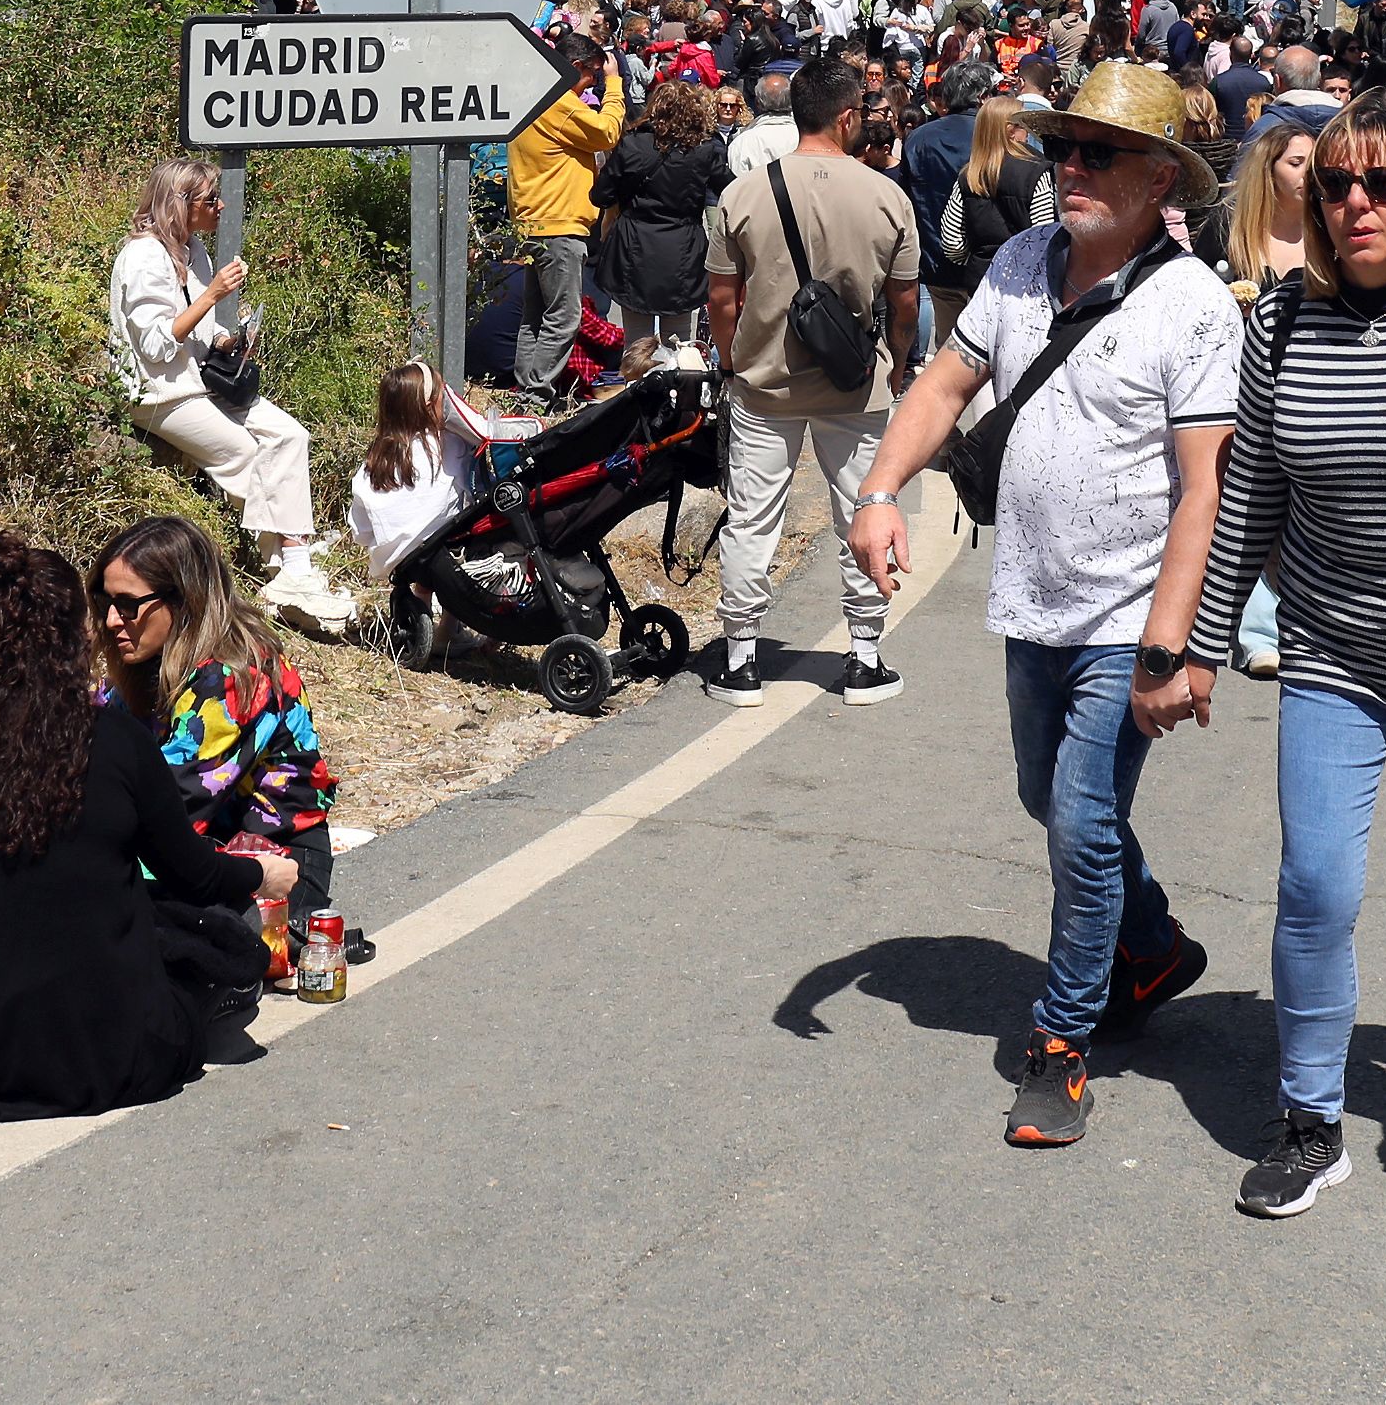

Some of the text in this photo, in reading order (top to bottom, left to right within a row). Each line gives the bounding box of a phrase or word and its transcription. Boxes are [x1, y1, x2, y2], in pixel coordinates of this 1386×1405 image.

[204, 37, 386, 76] MADRID
[203, 84, 510, 129] CIUDAD REAL
